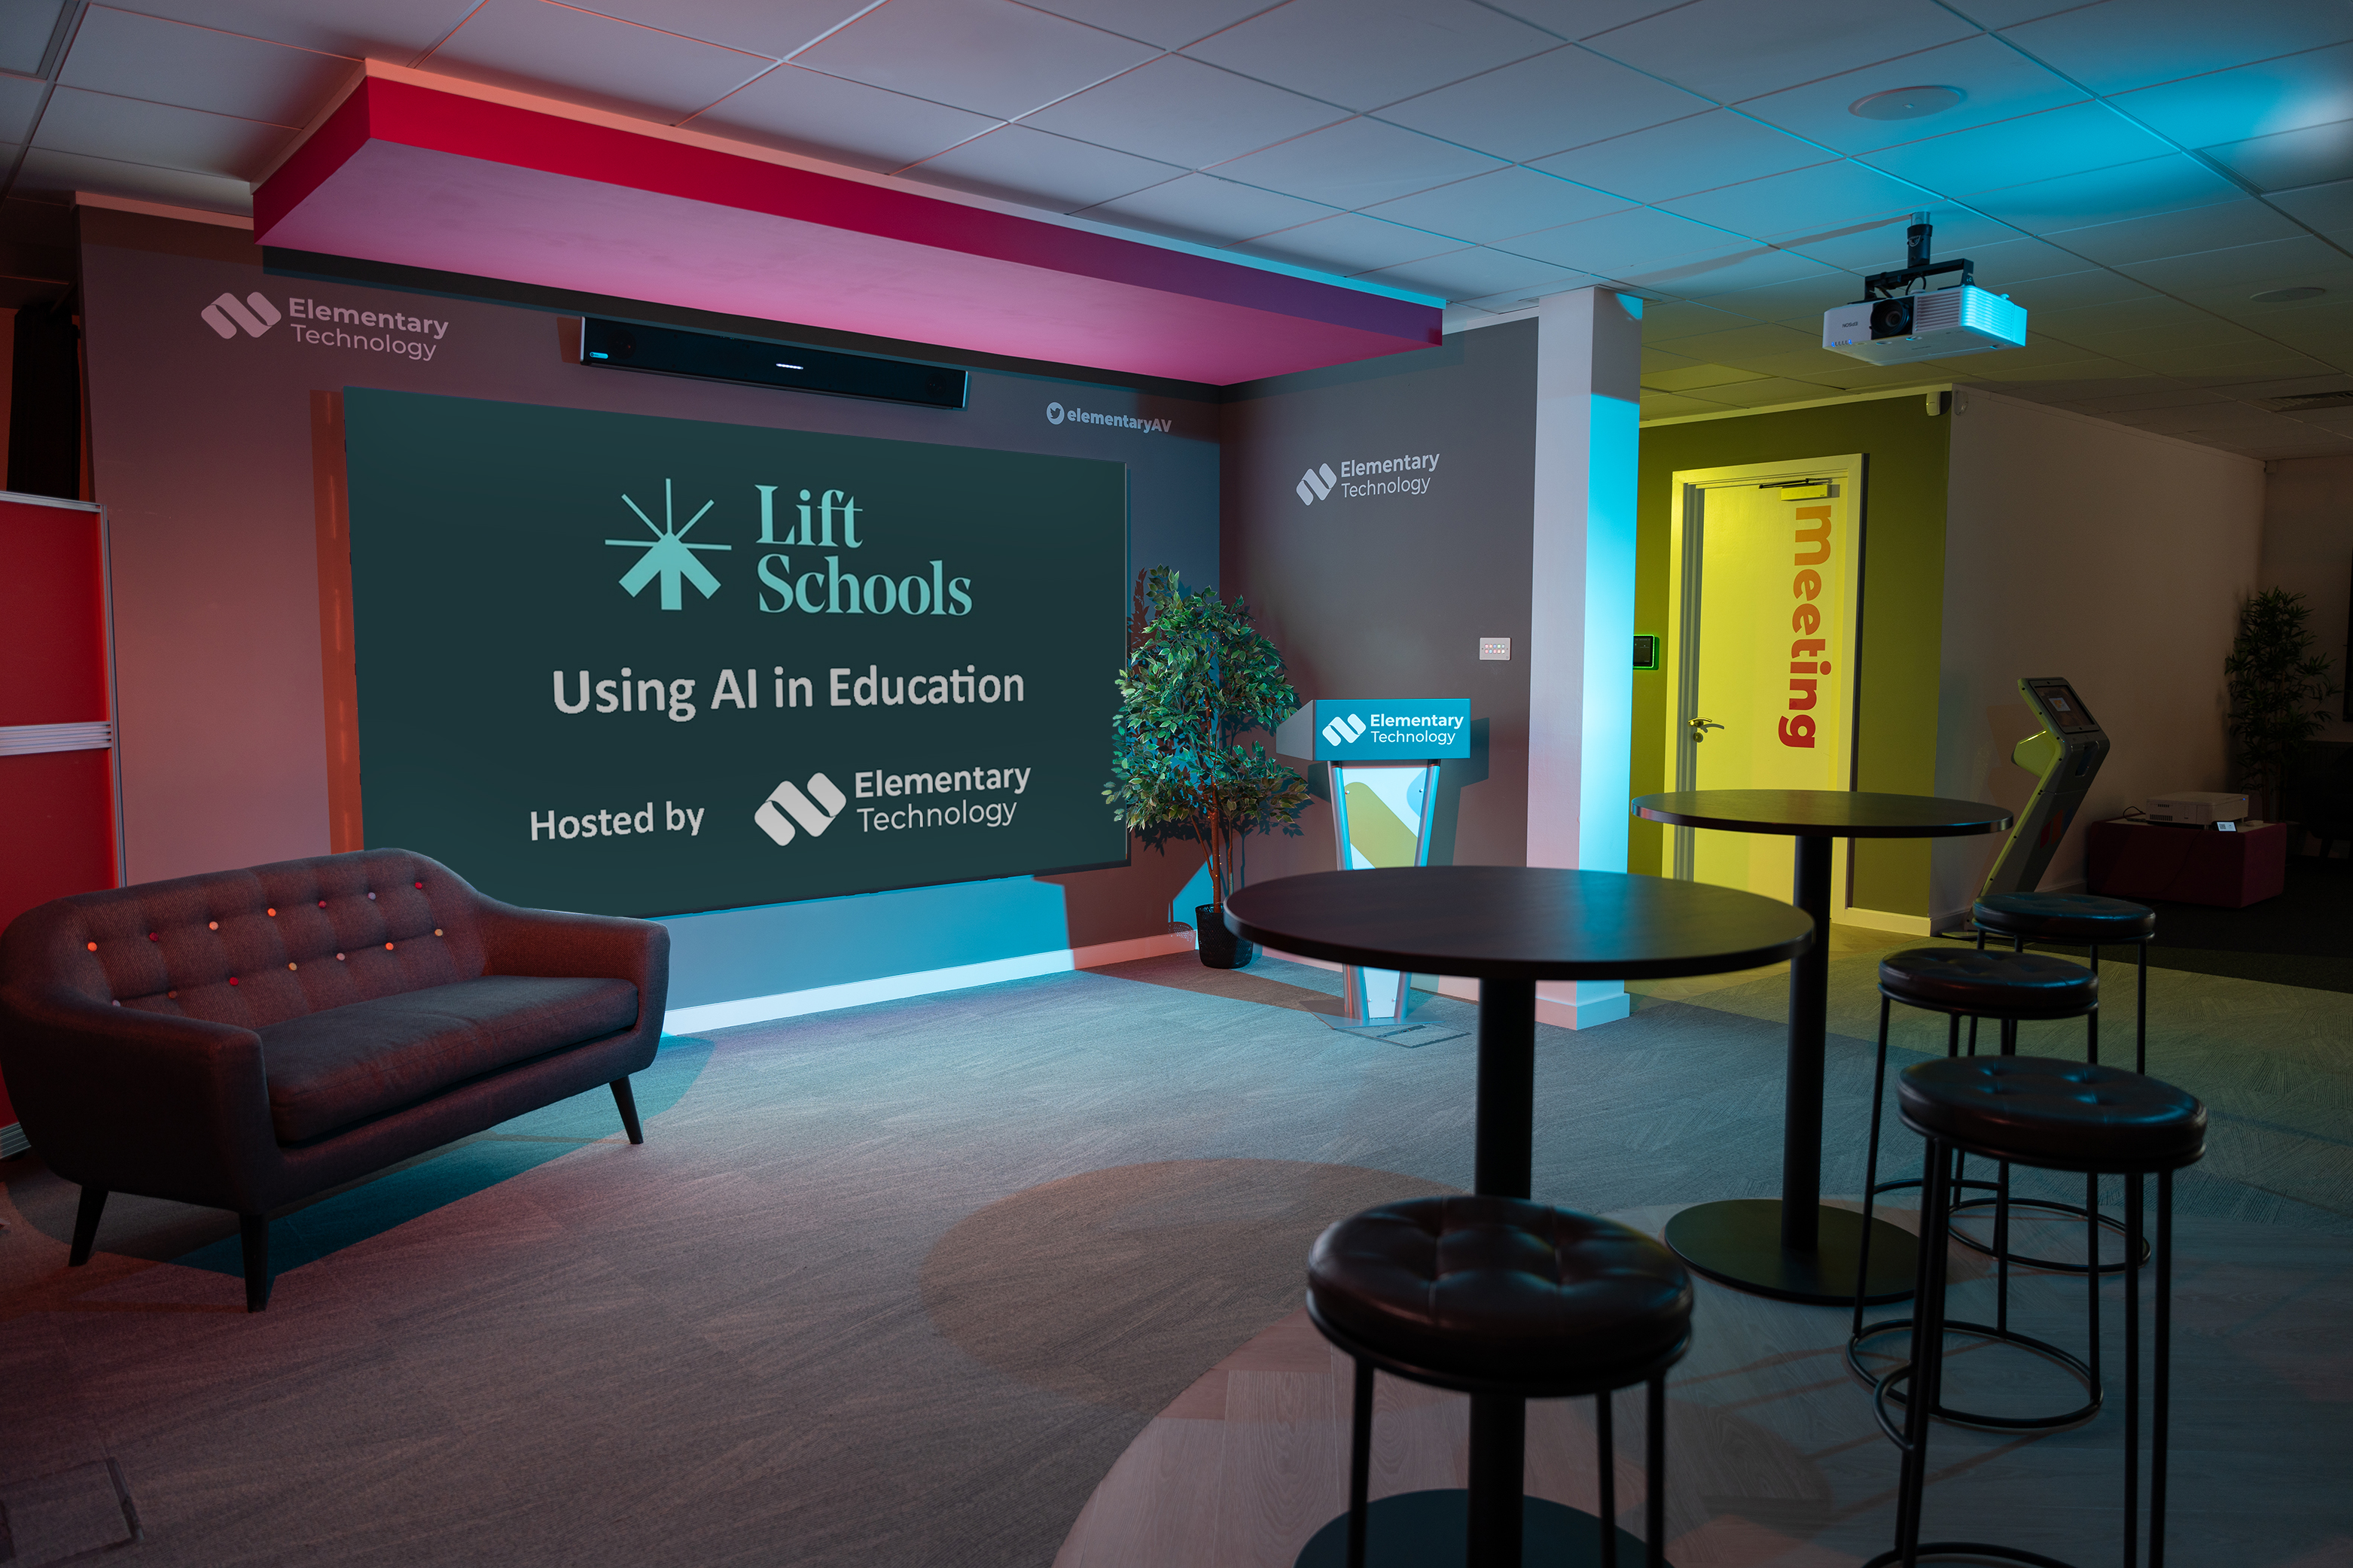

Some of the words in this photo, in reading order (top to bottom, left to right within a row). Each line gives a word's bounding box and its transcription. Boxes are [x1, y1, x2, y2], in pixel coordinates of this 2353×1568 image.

[289, 297, 450, 340] Elementary
[290, 323, 437, 361] Technology
[1067, 407, 1172, 434] elementaryAV
[1341, 453, 1440, 477] Elementary
[1341, 476, 1431, 498] Technology
[754, 484, 863, 548] Lift
[757, 553, 973, 616] Schools
[1778, 504, 1832, 749] meeting
[553, 667, 696, 723] Using
[710, 668, 757, 709] AI
[774, 665, 813, 708] in
[830, 664, 1025, 708] Education
[1370, 713, 1465, 729] Elementary
[1370, 729, 1456, 745] Technology
[855, 766, 1032, 799] Elementary
[530, 802, 654, 841] Hosted
[666, 800, 705, 836] by
[856, 799, 1017, 832] Technology
